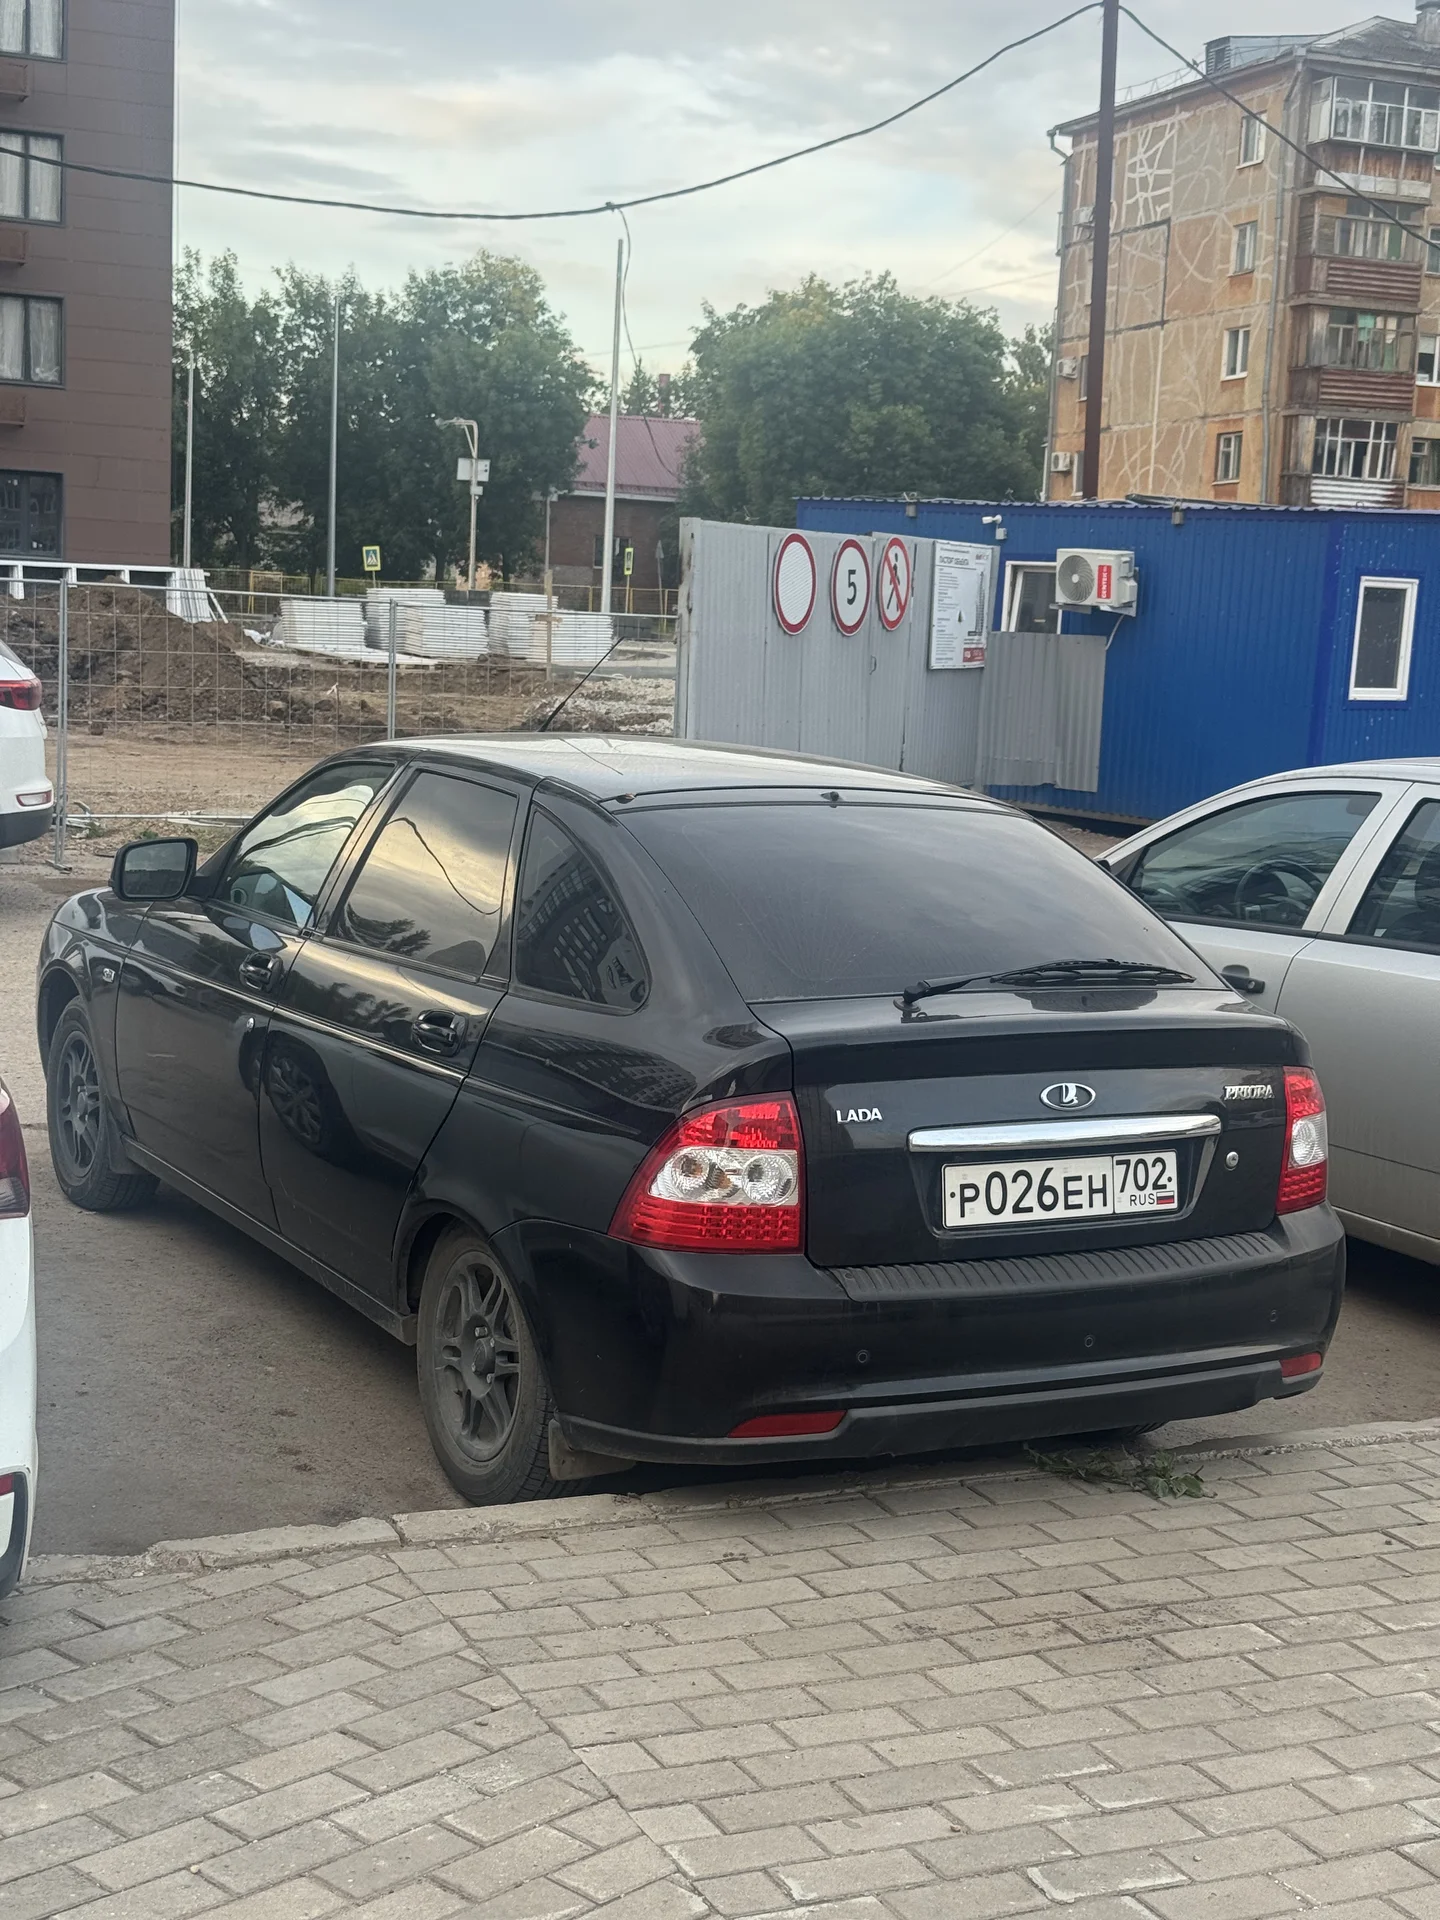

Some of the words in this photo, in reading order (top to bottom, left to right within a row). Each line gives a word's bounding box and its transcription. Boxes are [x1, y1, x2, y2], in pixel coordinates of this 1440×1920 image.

[847, 569, 857, 605] 5
[1224, 1085, 1275, 1100] PRIORA
[836, 1107, 884, 1123] LADA
[1115, 1157, 1168, 1193] 702
[1129, 1193, 1156, 1207] RUS
